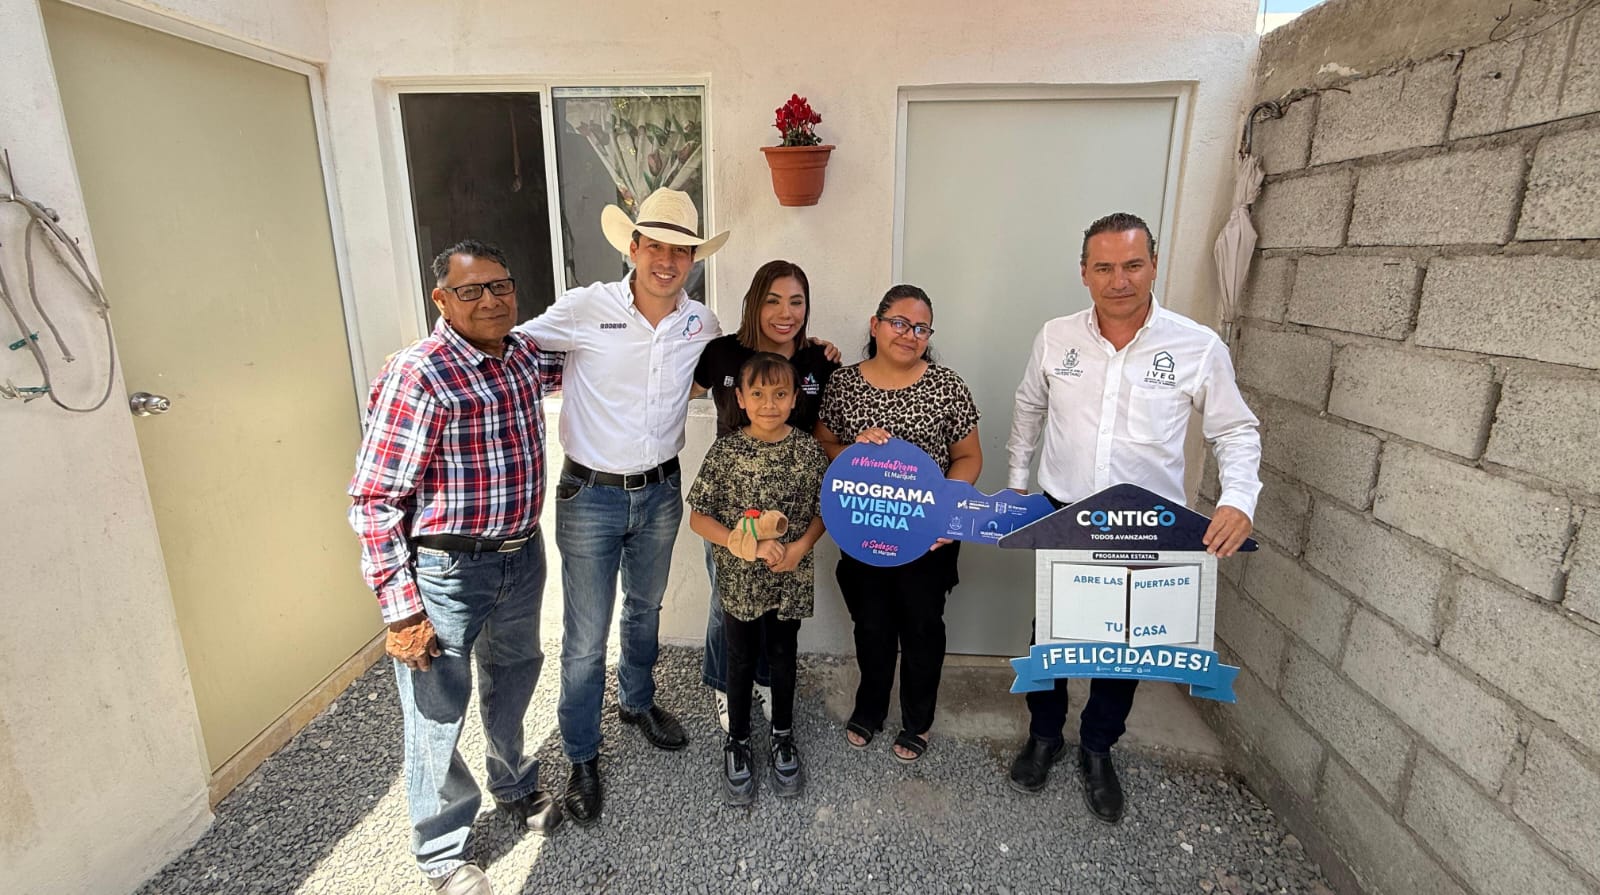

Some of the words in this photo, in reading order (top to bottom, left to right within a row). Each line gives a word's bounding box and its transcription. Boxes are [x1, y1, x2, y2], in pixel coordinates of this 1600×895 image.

[1146, 370, 1176, 380] IVEQ
[832, 479, 936, 505] PROGRAMA
[839, 494, 926, 519] VIVIENDA
[851, 511, 909, 531] DIGNA
[1076, 507, 1176, 530] CONTIGO
[1073, 575, 1101, 584] ABRE
[1104, 577, 1124, 586] LAS
[1134, 579, 1176, 589] PUERTAS
[1177, 577, 1190, 586] DE
[1105, 621, 1123, 632] TU
[1133, 625, 1167, 637] CASA
[1042, 647, 1211, 672] ¡FELICIDADES!
